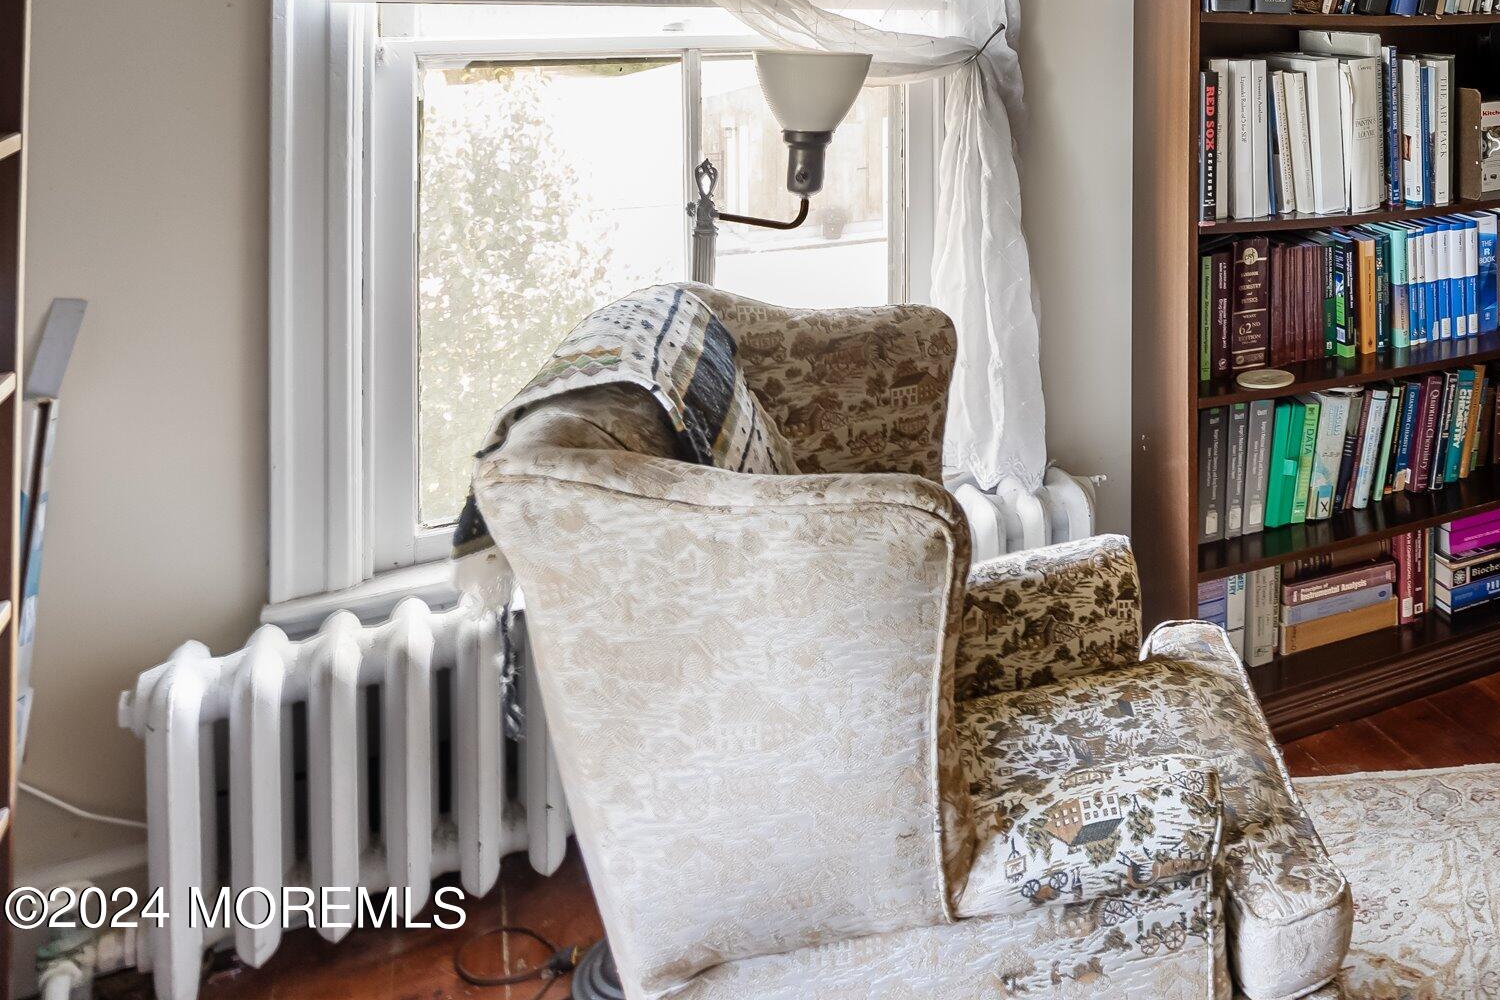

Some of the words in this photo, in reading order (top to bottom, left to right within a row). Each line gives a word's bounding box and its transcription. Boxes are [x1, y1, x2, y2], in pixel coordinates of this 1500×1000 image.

[1206, 86, 1215, 116] RED
[1439, 76, 1447, 99] THE
[1206, 121, 1216, 150] SOX
[1479, 255, 1495, 264] BOOK
[1239, 283, 1261, 291] CHEMISTRY
[1405, 391, 1415, 422] QUANTUM
[1424, 388, 1440, 428] Quantum
[1453, 389, 1466, 448] CHEMISTRY
[1303, 427, 1314, 455] DATA
[1401, 422, 1411, 455] CHEMISTRY
[1418, 427, 1435, 470] Chemistry
[1300, 587, 1340, 601] Instrumental
[1341, 579, 1367, 592] Analysis
